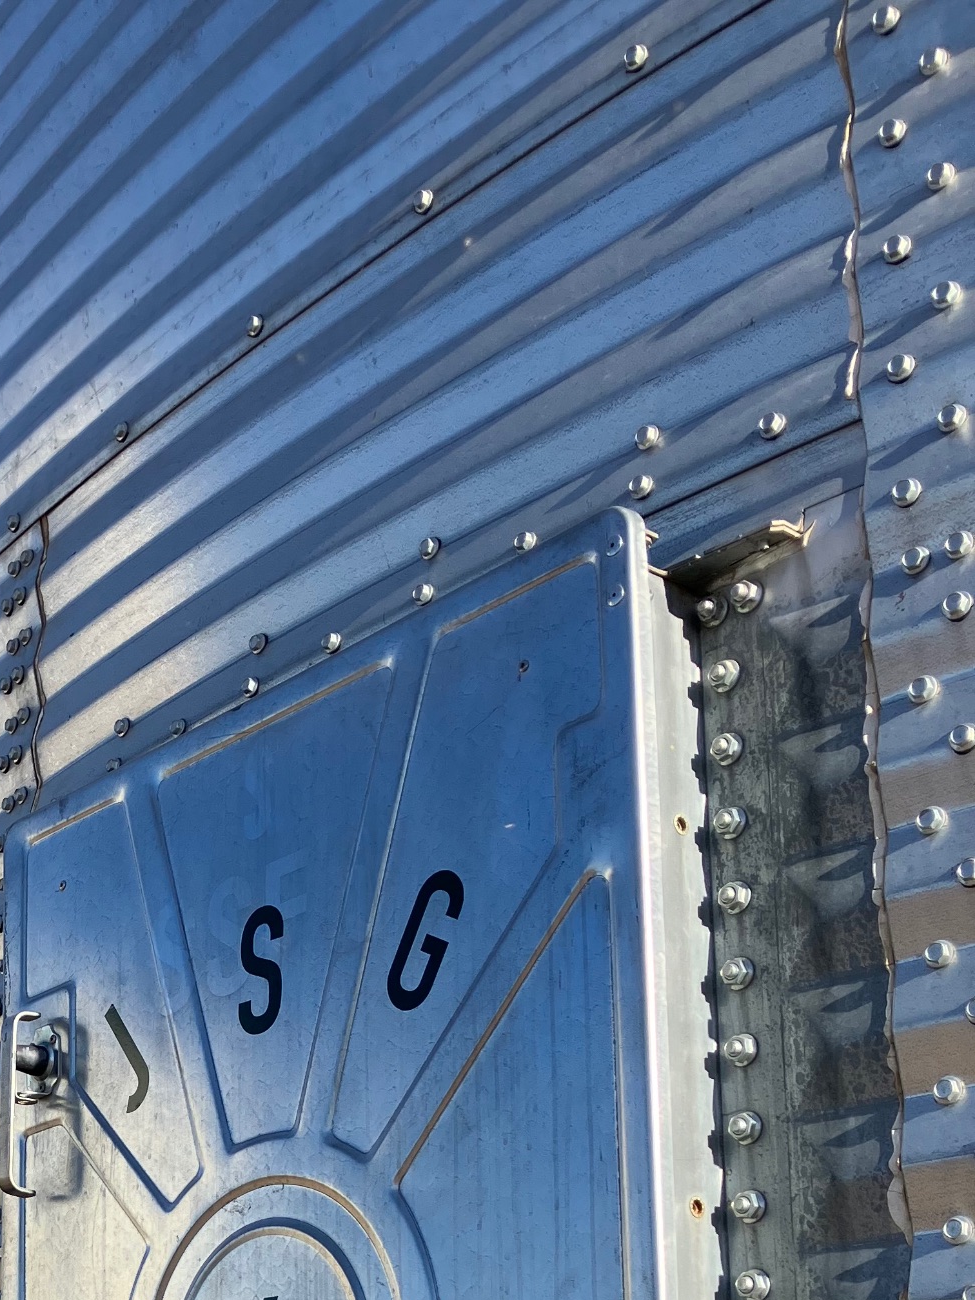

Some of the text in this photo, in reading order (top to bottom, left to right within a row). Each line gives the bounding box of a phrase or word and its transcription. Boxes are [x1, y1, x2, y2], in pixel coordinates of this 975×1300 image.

[104, 1003, 150, 1113] J
[238, 904, 284, 1035] S
[387, 870, 465, 1012] G
